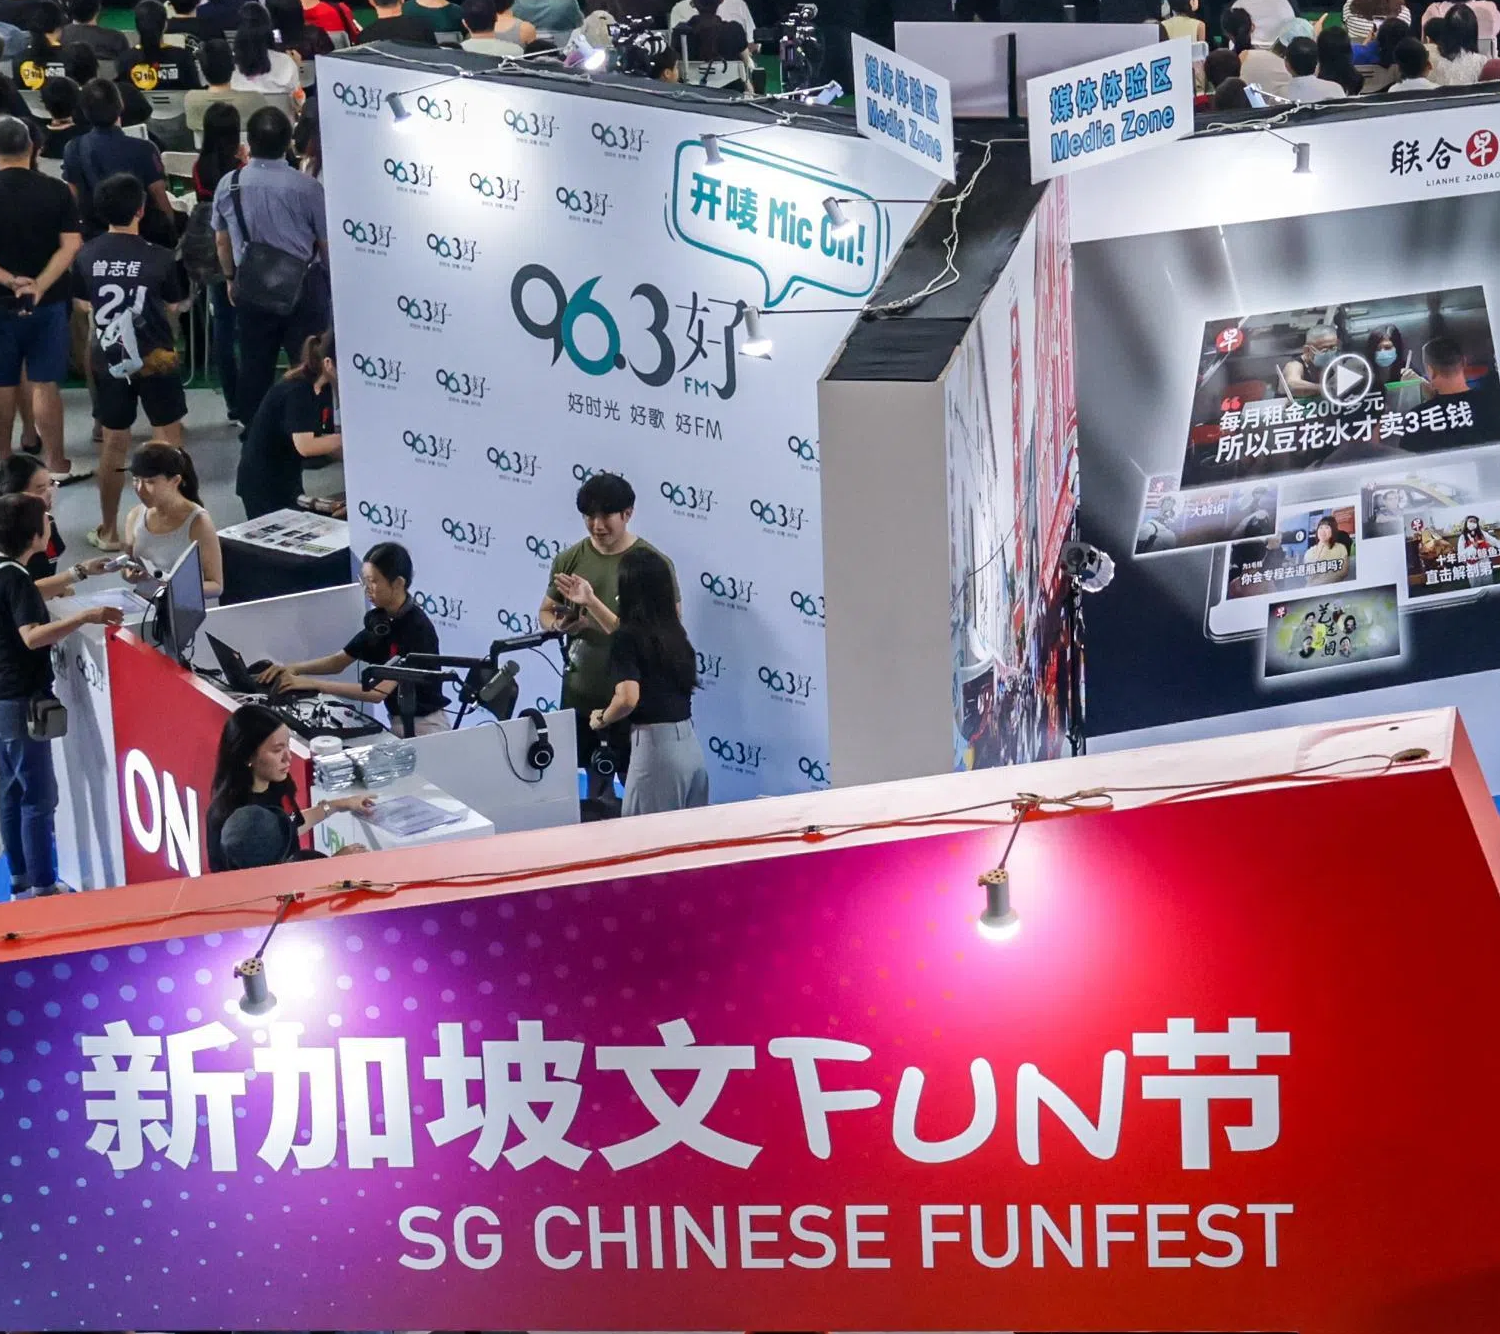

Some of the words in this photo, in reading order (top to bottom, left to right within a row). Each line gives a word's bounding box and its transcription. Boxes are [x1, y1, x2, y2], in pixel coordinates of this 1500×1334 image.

[864, 52, 940, 126] 媒体体验区
[1049, 56, 1173, 125] 媒体体验区
[865, 96, 907, 145] Media
[909, 119, 943, 163] Zone
[1049, 99, 1116, 164] Media
[1120, 104, 1175, 142] Zone
[689, 171, 758, 236] 开唛
[767, 198, 813, 250] Mic
[1426, 175, 1460, 187] LIANHE
[1465, 170, 1500, 183] ZAOBAO
[510, 263, 762, 400] 96.3好
[567, 391, 621, 422] 好时光
[629, 404, 666, 431] 好歌
[674, 412, 723, 442] 好FM
[683, 376, 710, 397] FM
[1214, 400, 1475, 465] 所以豆花水才卖3毛钱
[123, 747, 201, 879] ON
[80, 1016, 1293, 1174] 新加坡文FUN节
[398, 1205, 503, 1271] SG
[532, 1204, 892, 1271] CHINESE
[921, 1203, 1296, 1271] FUNFEST
